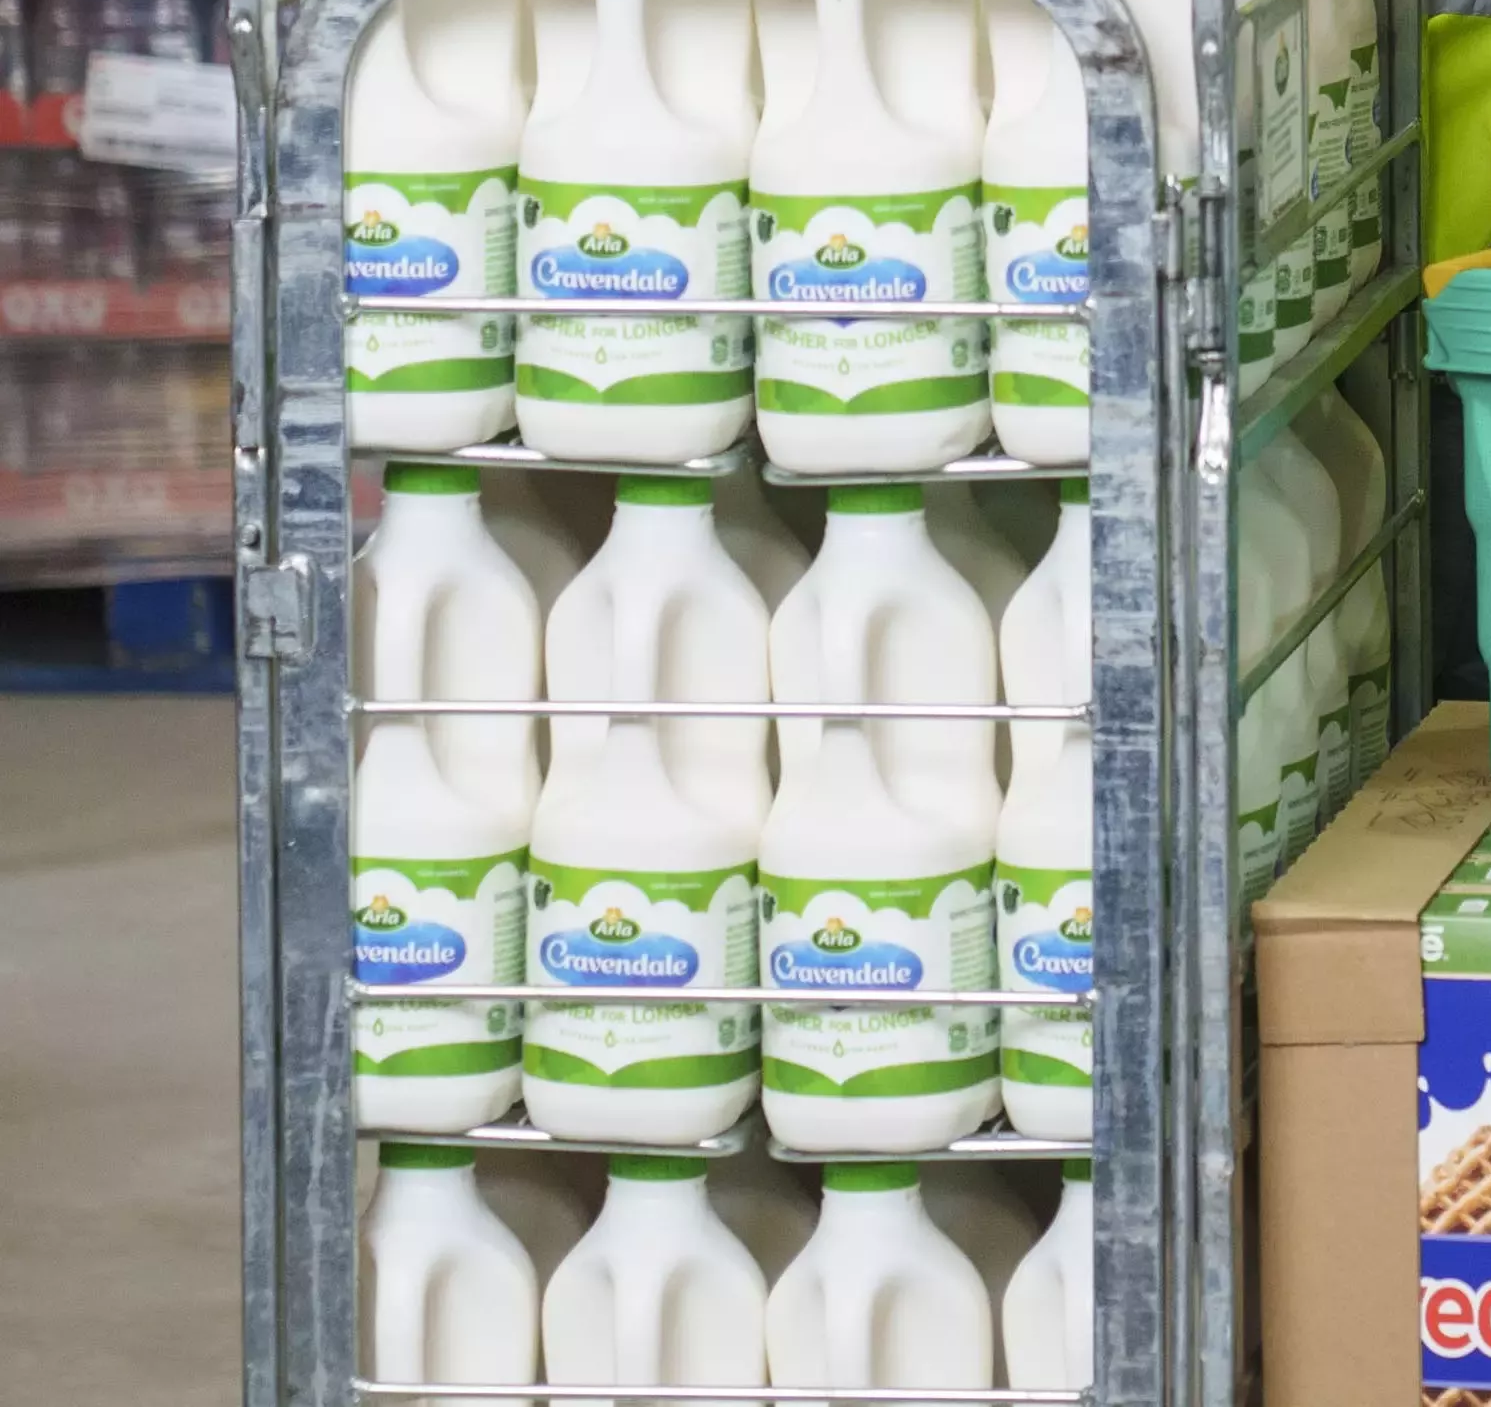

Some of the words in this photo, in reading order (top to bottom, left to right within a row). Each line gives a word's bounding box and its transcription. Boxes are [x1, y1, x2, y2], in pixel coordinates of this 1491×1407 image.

[354, 224, 393, 241] Arla
[583, 236, 621, 253] Arla
[820, 246, 858, 263] Arla
[536, 256, 679, 292] Cravendale
[774, 270, 917, 301] Cravendale
[362, 910, 400, 927] Arla
[595, 921, 633, 939] Arla
[818, 930, 855, 947] Arla
[546, 940, 688, 977] Cravendale
[774, 954, 912, 986] Cravendale
